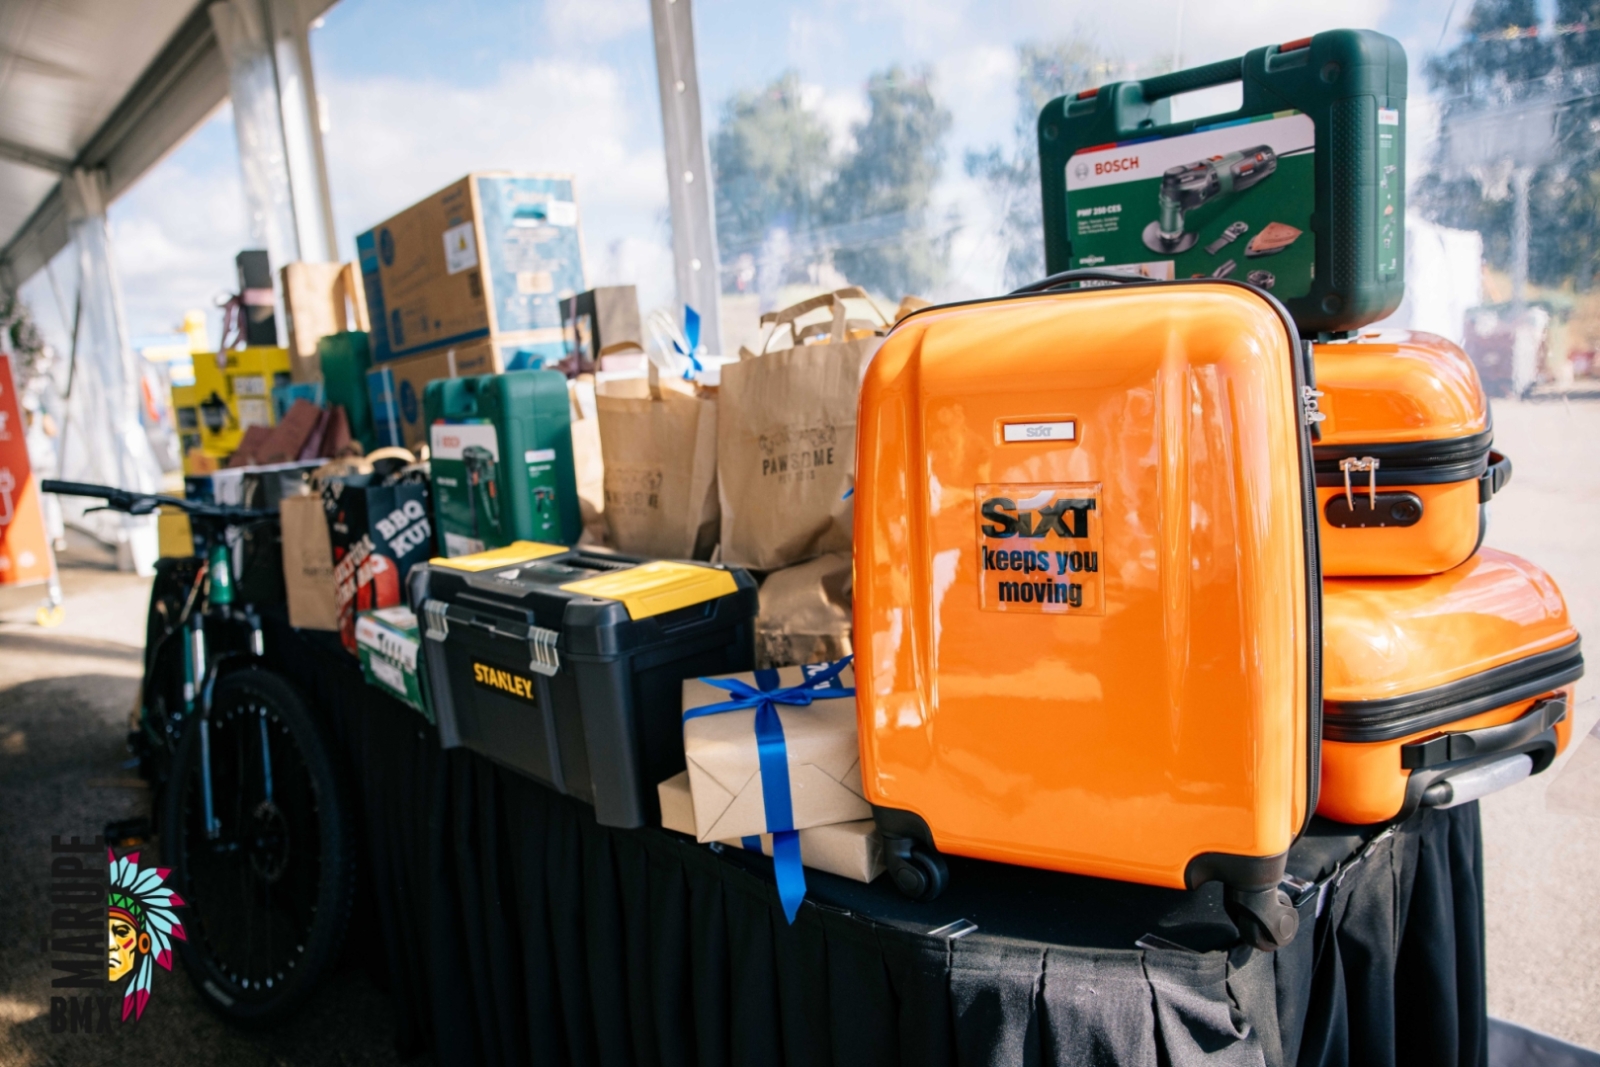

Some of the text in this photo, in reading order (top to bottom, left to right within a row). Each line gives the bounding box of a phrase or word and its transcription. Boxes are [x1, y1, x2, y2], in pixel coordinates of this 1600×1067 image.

[1094, 156, 1140, 176] BOSCH
[762, 447, 834, 477] PAWSOME
[375, 499, 426, 541] BBQ
[981, 545, 1098, 576] keeps you
[998, 578, 1083, 608] moving
[473, 662, 534, 699] STANLEY
